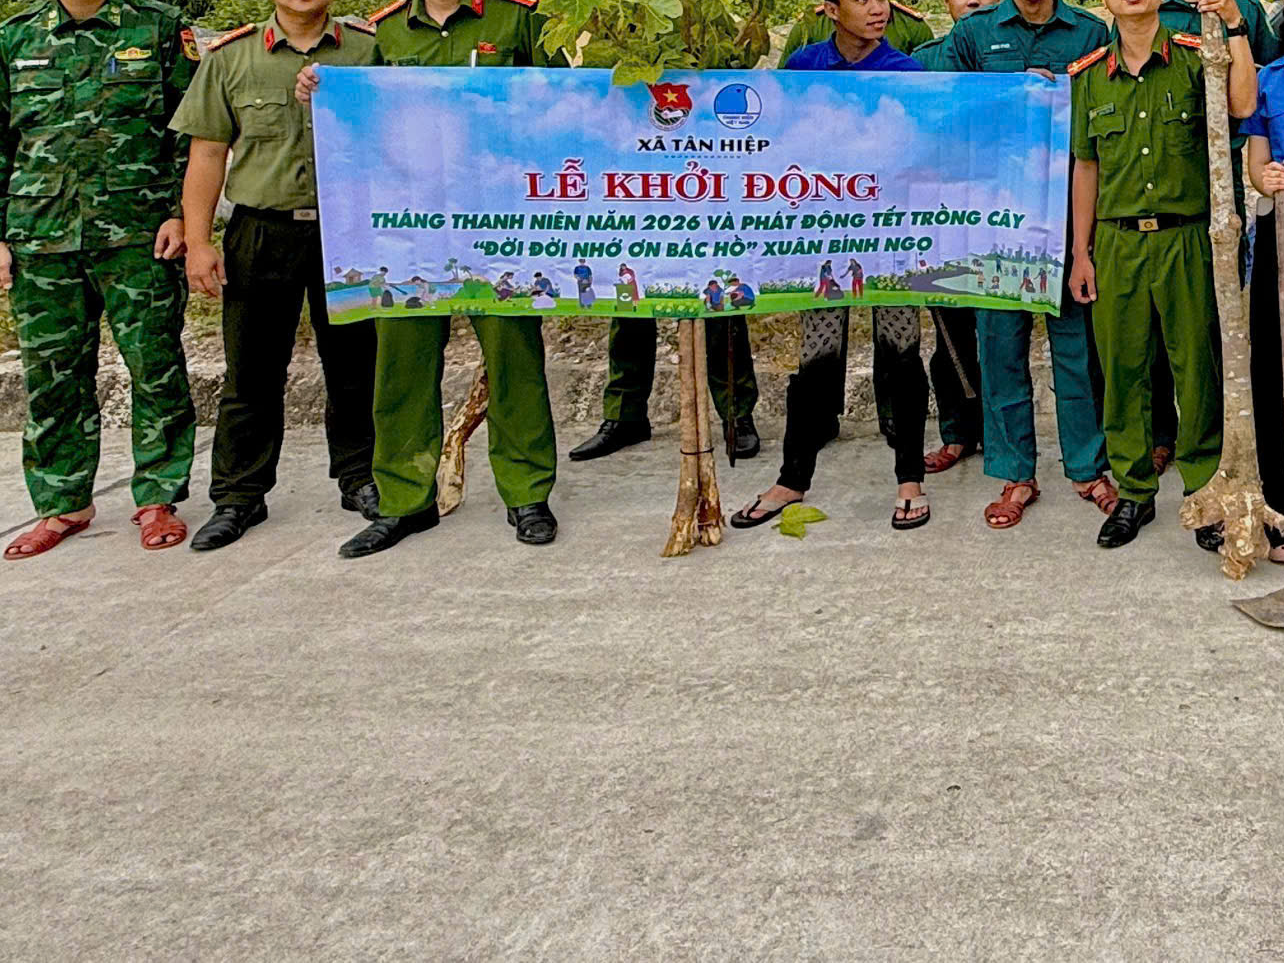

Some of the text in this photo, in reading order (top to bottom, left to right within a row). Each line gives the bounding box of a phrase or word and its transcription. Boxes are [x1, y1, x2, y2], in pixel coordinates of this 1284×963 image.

[637, 135, 770, 155] XÃ TÂN HIỆP
[523, 158, 881, 208] LỄ KHỞI ĐỘNG
[370, 203, 1026, 233] THÁNG THANH NIÊN NĂM 2026 VÀ PHÁT ĐỘNG TẾT TRỒNG CÂY
[473, 234, 934, 258] “ĐỜI ĐỜI NHỚ ƠN BÁC HỒ” XUÂN BÍNH NGỌ
